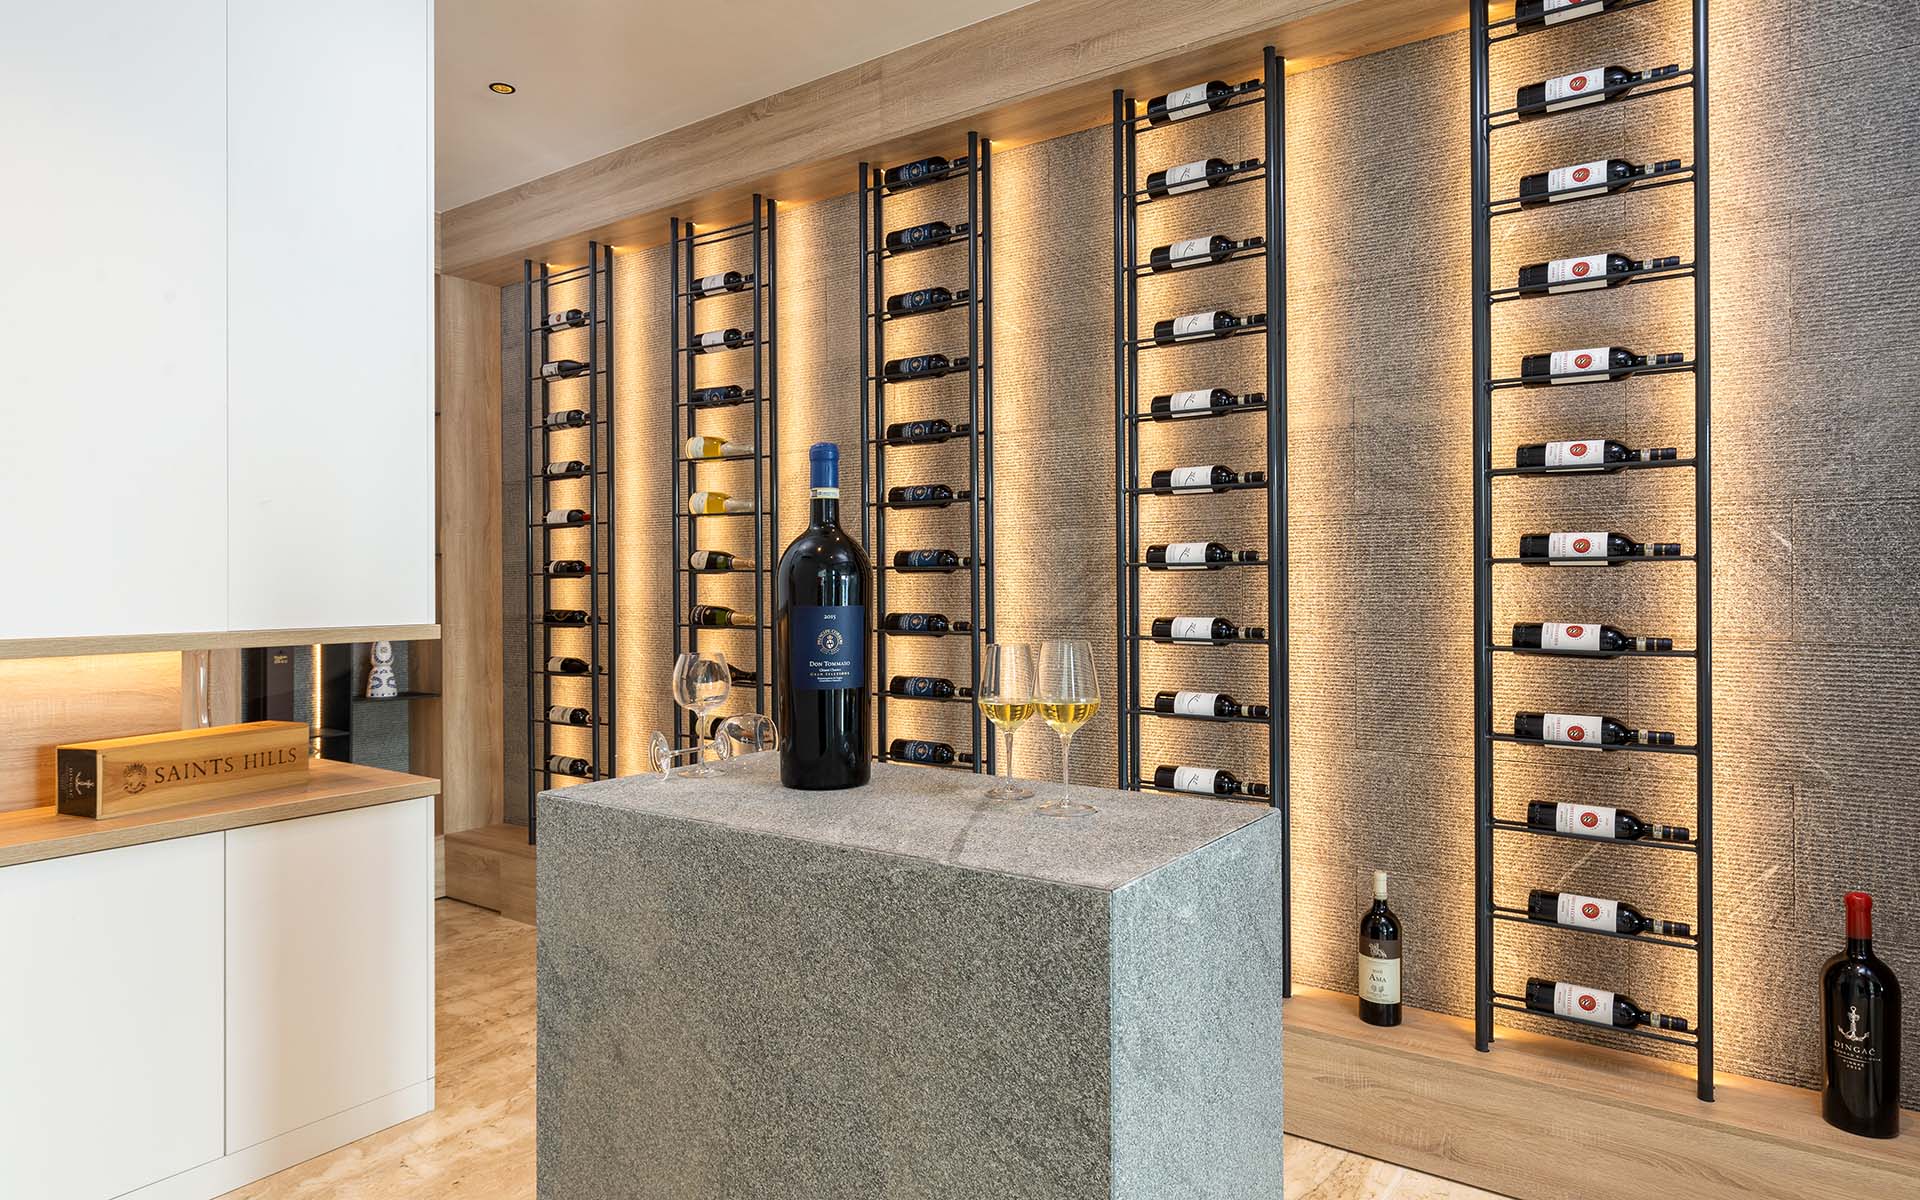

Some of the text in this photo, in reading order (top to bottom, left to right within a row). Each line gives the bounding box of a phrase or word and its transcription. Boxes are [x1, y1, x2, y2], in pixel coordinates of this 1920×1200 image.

[154, 747, 297, 784] SAINTS HILLS
[1834, 1040, 1876, 1056] DINGAČ
